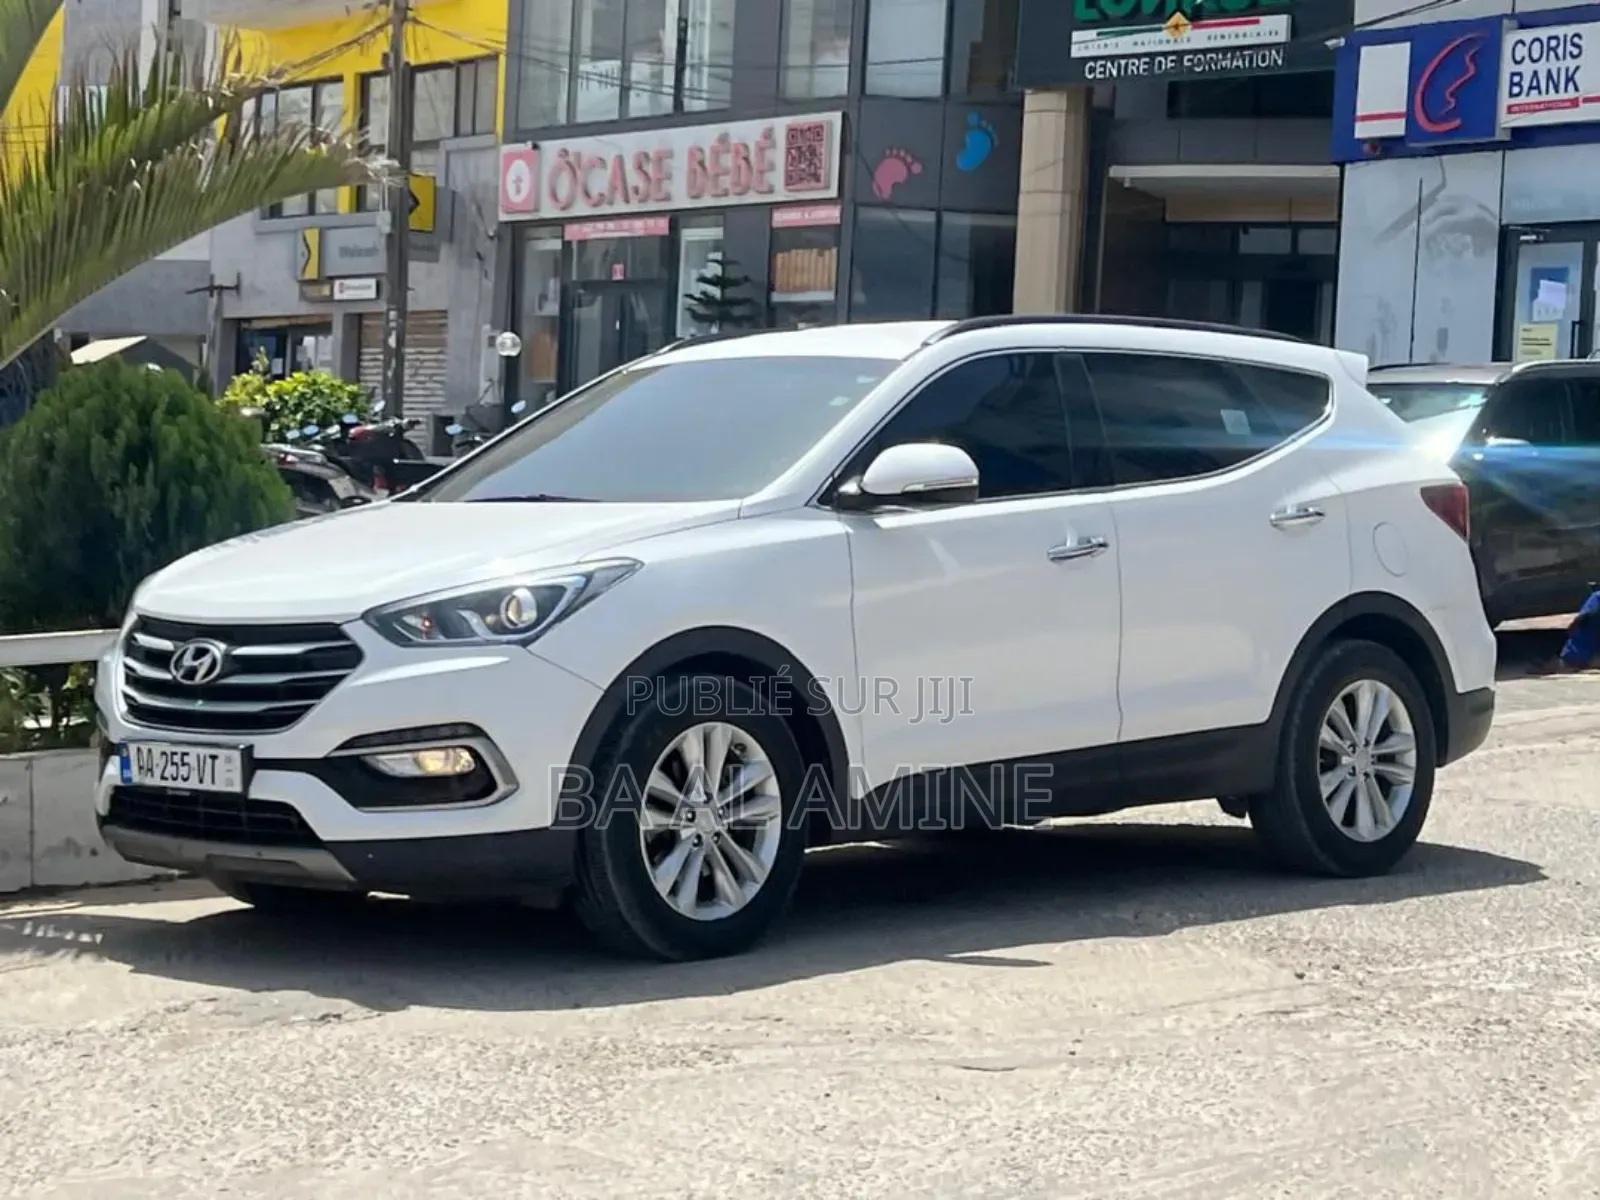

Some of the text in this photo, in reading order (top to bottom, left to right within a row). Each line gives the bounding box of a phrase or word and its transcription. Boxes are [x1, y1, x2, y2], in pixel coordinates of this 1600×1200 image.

[1084, 48, 1284, 80] CENTRE DE FORMATION
[1510, 32, 1583, 65] CORIS
[1508, 65, 1581, 99] BANK
[686, 121, 778, 199] BÉBÉ
